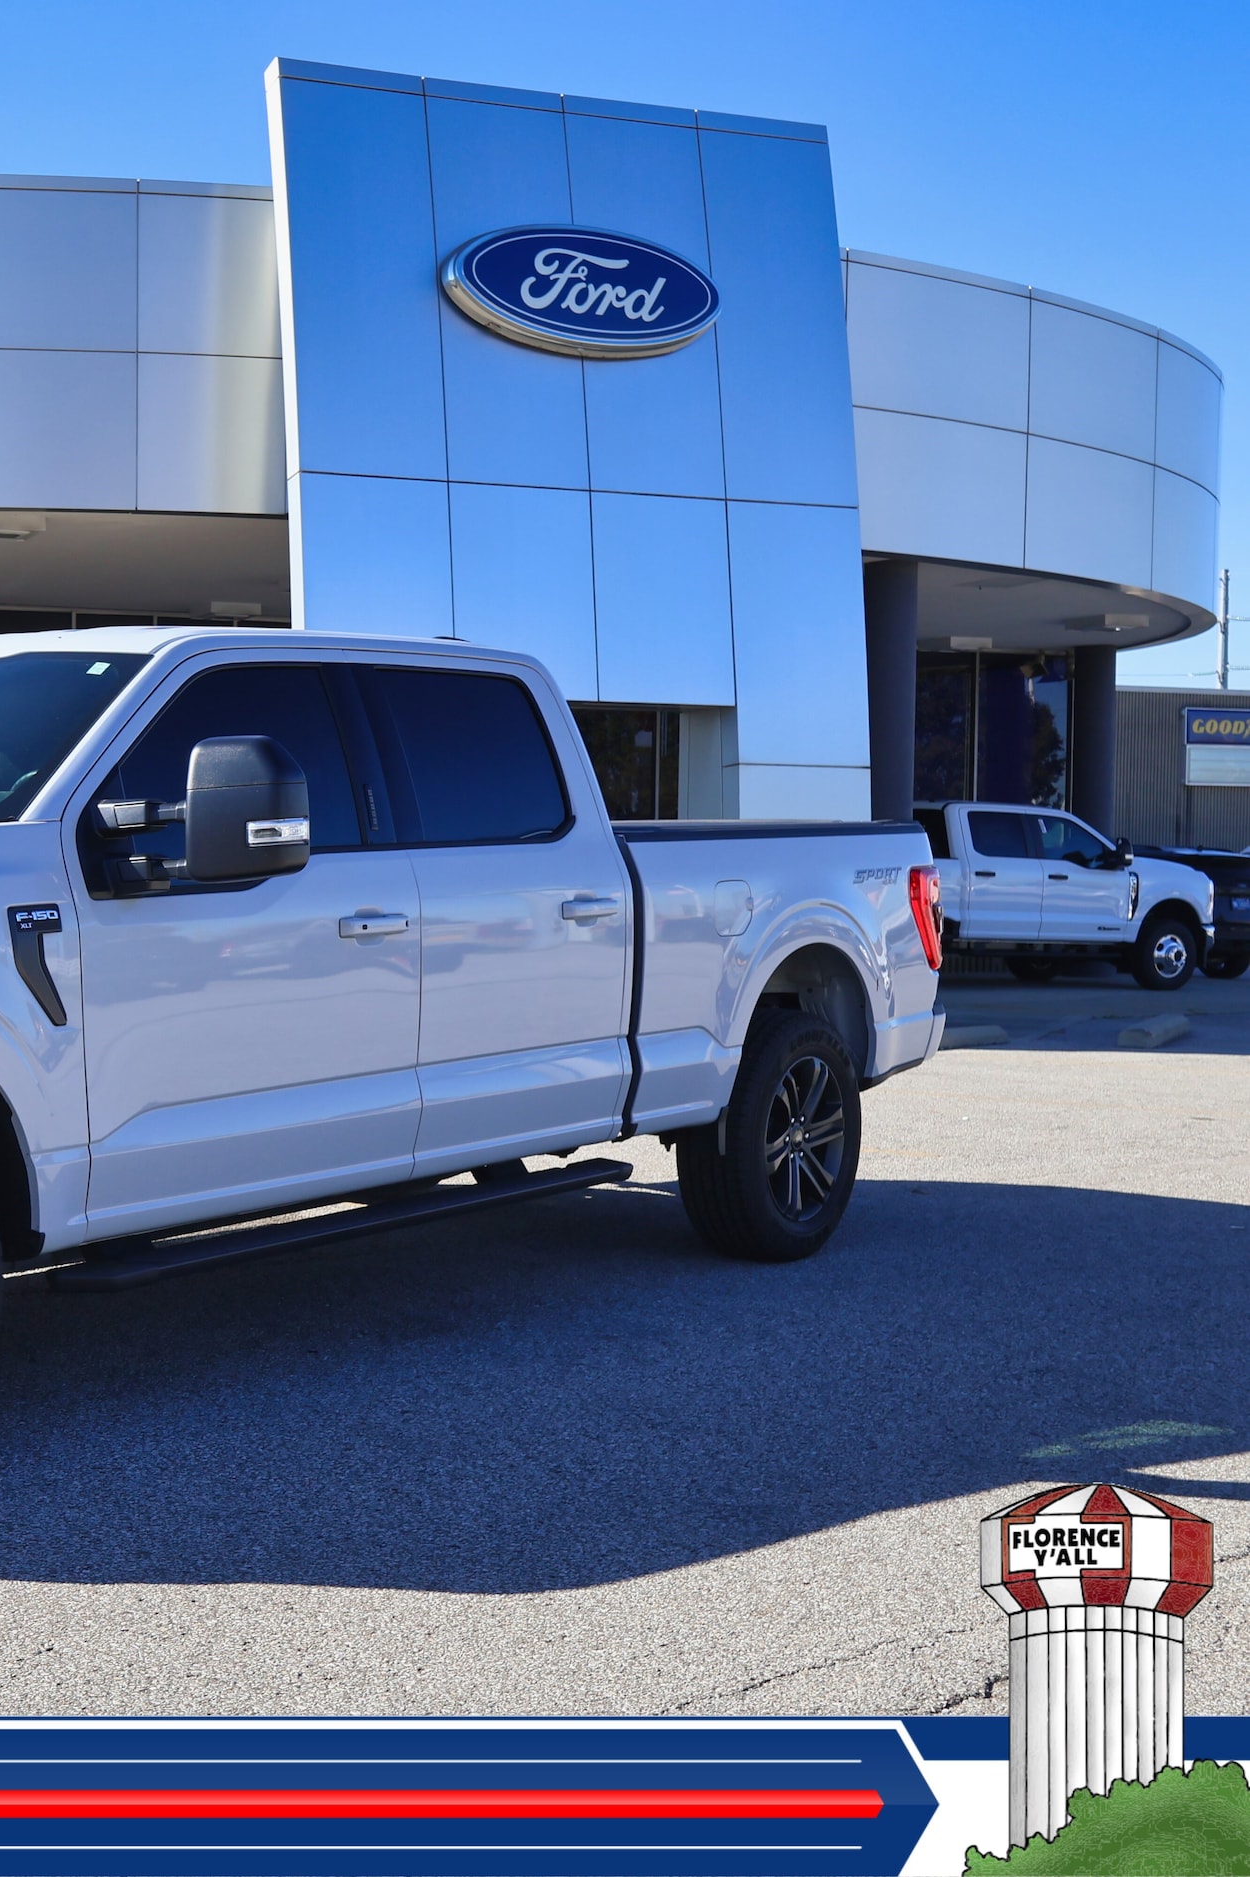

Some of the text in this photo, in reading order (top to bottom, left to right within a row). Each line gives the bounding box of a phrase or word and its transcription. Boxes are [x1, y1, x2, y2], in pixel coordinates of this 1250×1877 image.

[520, 247, 667, 323] Ford
[853, 866, 902, 884] SPORT
[15, 910, 59, 922] F-150
